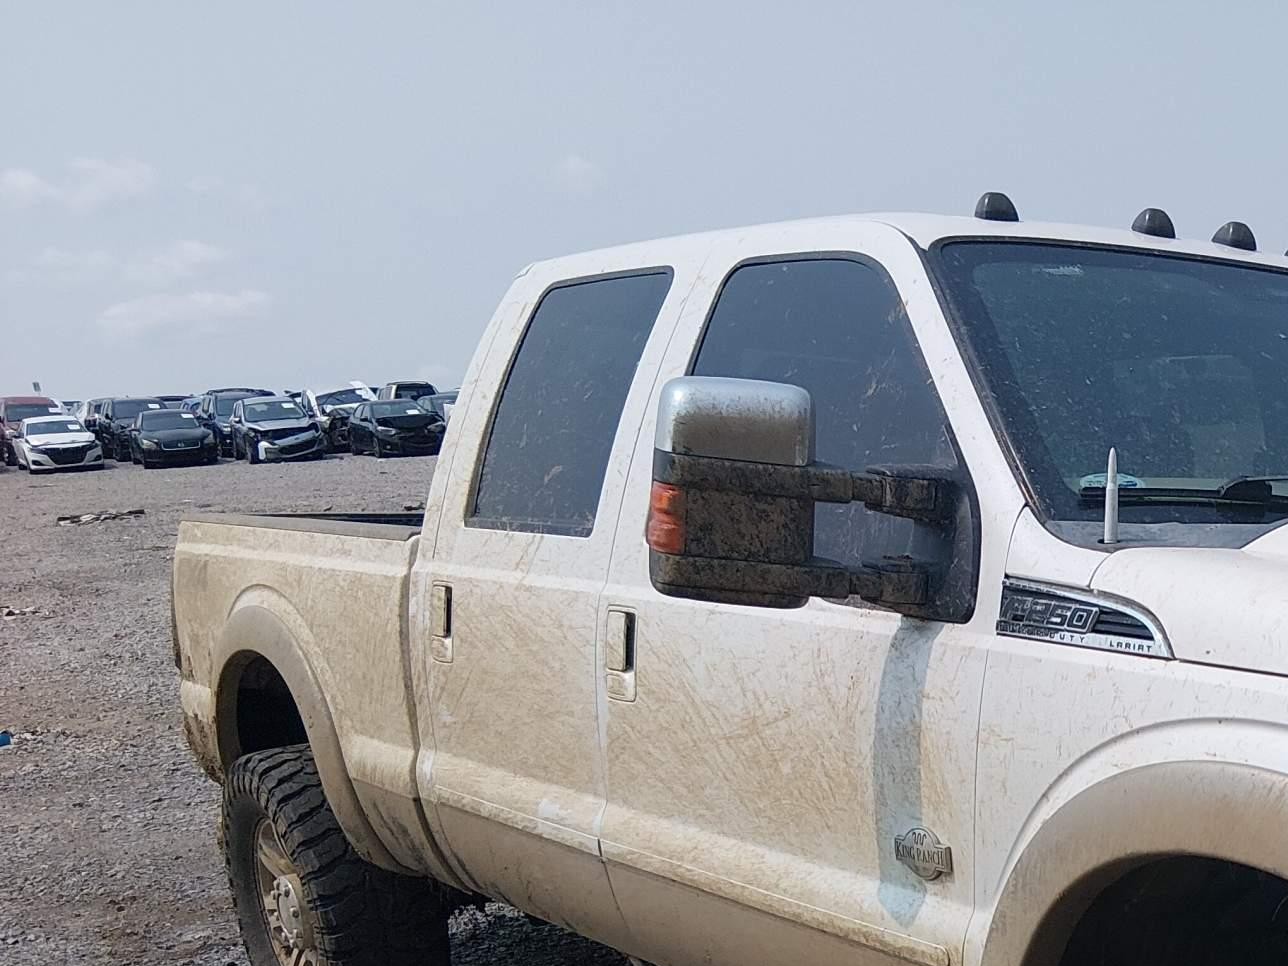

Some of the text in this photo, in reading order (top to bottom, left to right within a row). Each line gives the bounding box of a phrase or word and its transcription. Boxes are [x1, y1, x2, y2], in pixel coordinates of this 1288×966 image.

[1109, 639, 1153, 652] LARIAT
[896, 840, 943, 866] KING RANCH
